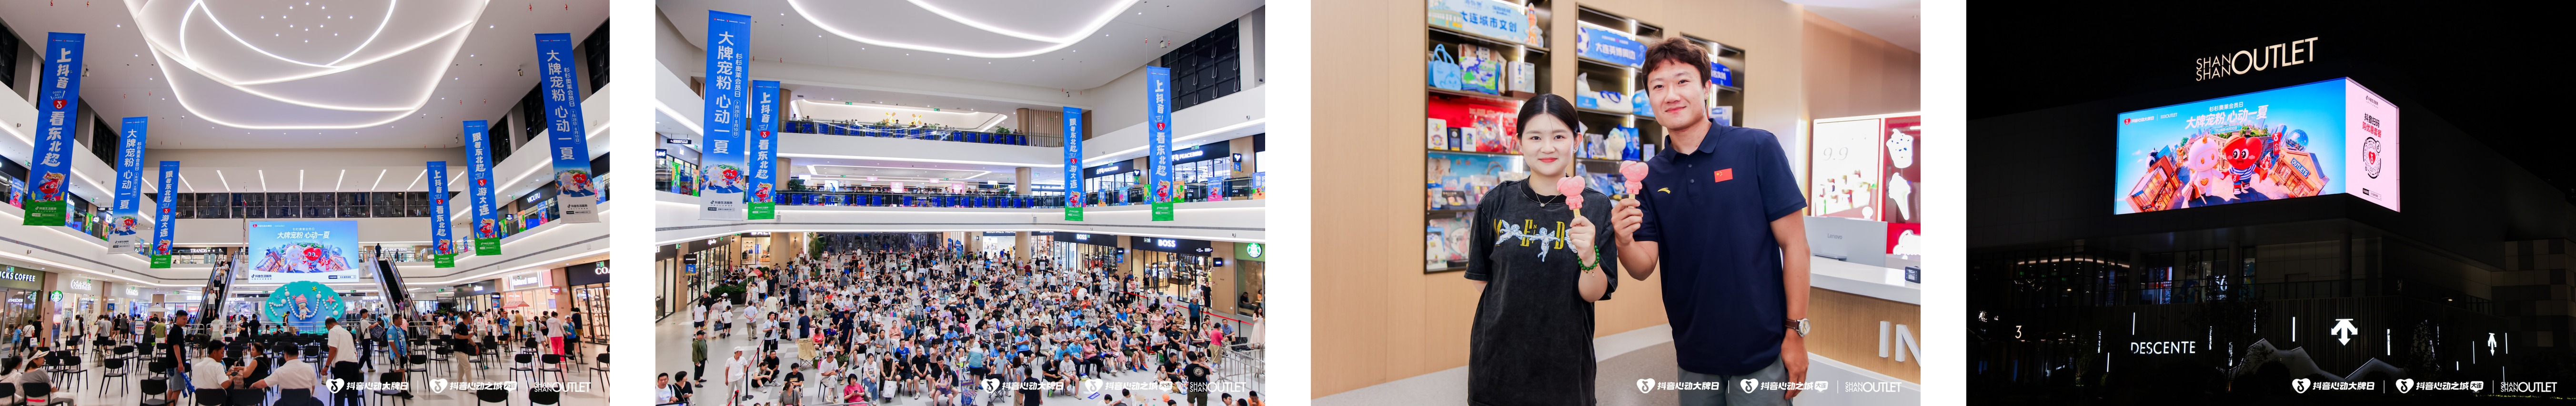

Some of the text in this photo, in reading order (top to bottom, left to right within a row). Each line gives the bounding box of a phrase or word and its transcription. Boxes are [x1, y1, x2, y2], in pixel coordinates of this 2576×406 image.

[1460, 10, 1517, 32] 大连城市文创
[56, 48, 71, 89] 上抖音
[716, 31, 734, 90] 大牌宠粉
[2196, 37, 2318, 81] SHAN SHAN OUTLET
[564, 67, 575, 107] 杉杉奥莱会员日
[735, 53, 743, 98] 杉杉奥莱会员日
[546, 50, 574, 160] 大牌宠粉 心动一夏
[2185, 105, 2269, 129] 大牌宠粉 心动一夏
[2209, 101, 2244, 112] 杉杉奥莱会员日
[714, 94, 732, 154] 心动一夏
[1155, 79, 1167, 176] 上抖音 看东北超
[2362, 121, 2382, 139] 购优惠套餐
[2364, 112, 2380, 128] 抖音扫码
[40, 111, 65, 167] 看东北超
[755, 92, 771, 179] 上抖音 看东北超
[1069, 118, 1077, 152] 跟着东北超
[124, 129, 137, 167] 大牌宠粉
[1823, 147, 1848, 161] 9.9
[2274, 143, 2279, 152] 心仔
[472, 132, 490, 216] 跟着东北超 游大连
[1069, 165, 1077, 189] 游大连
[2292, 158, 2309, 177] OUTLETS
[120, 170, 133, 209] 心动一夏
[162, 170, 173, 203] 跟着东北超
[434, 170, 442, 193] 上抖音
[527, 192, 541, 203] VICUTU
[160, 215, 170, 238] 游大连
[436, 206, 446, 237] 看东北超
[277, 231, 330, 239] 大牌宠粉 心动一夏
[1158, 239, 1176, 248] BOSS
[14, 273, 35, 282] COFFEE
[2015, 325, 2022, 339] 3
[2131, 341, 2195, 355] DESCENTE
